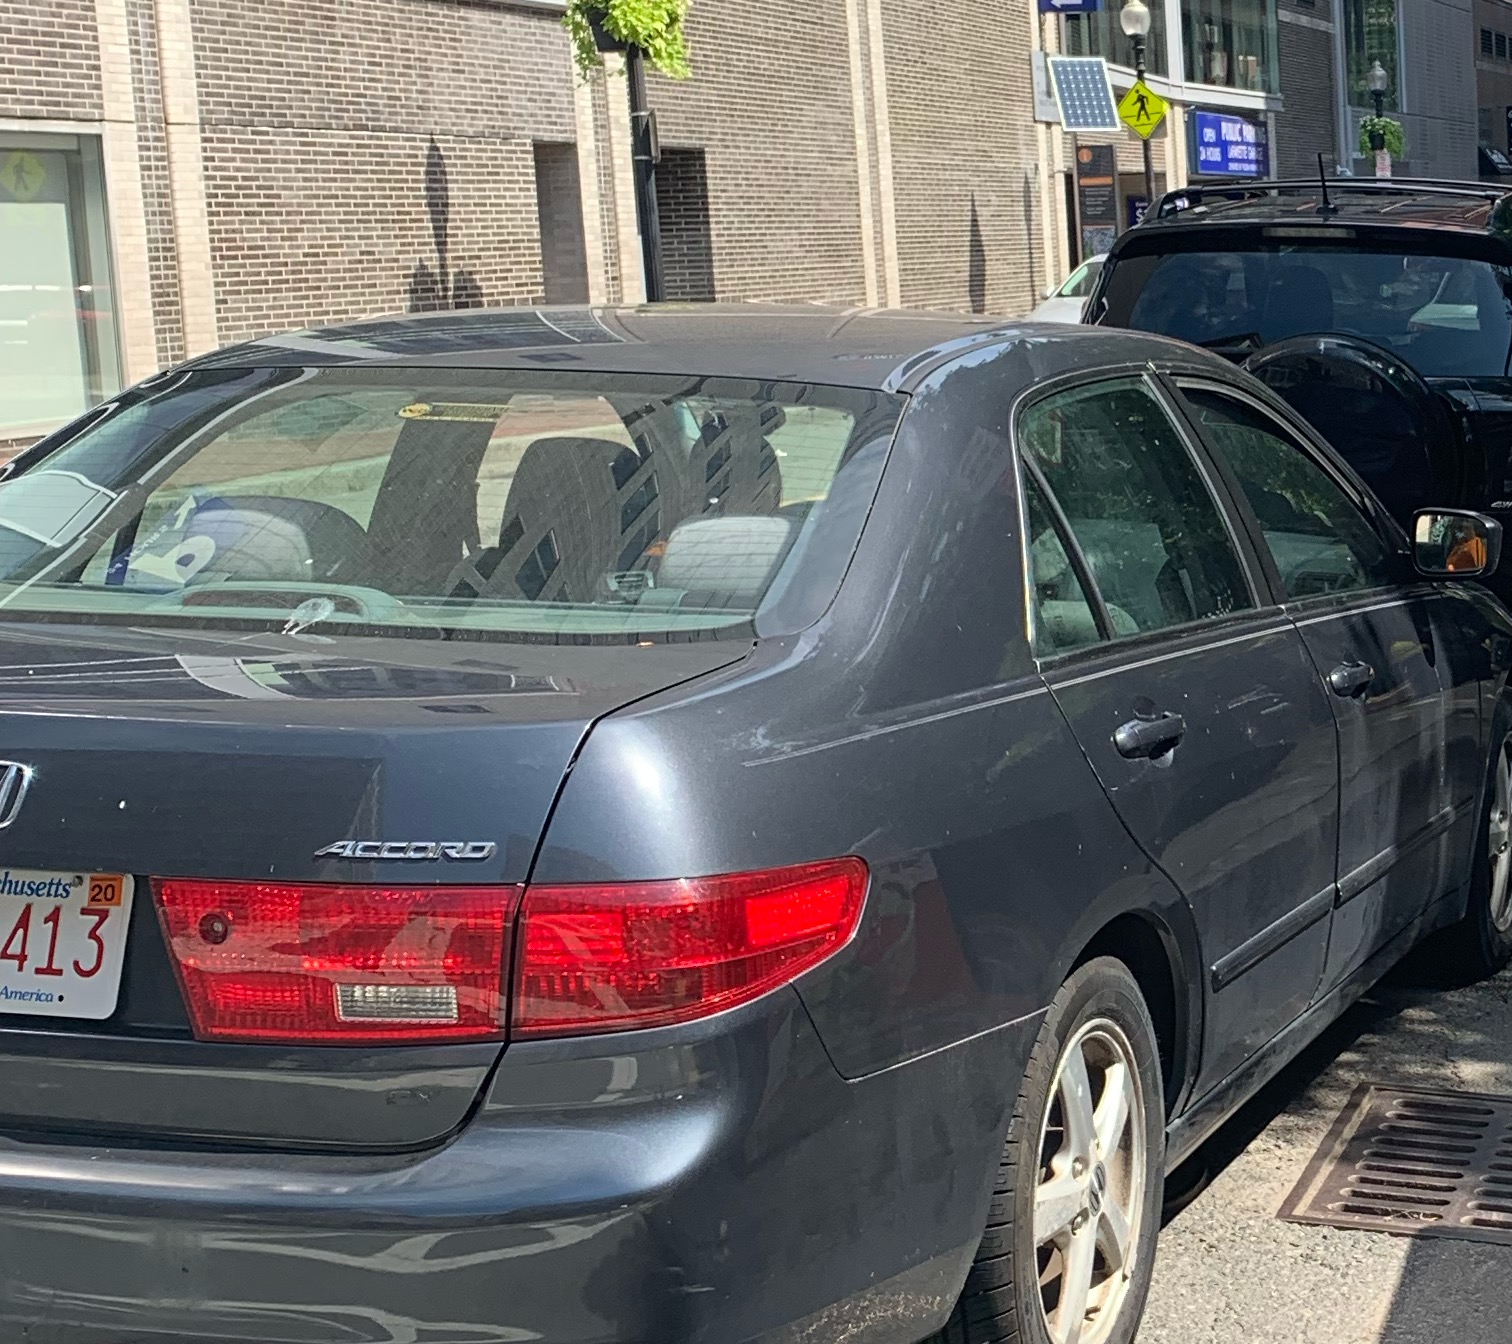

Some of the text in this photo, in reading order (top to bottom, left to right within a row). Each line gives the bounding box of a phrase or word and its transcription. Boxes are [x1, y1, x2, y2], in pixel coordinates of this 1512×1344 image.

[313, 840, 498, 861] ACCORD
[0, 871, 115, 902] husetts 20
